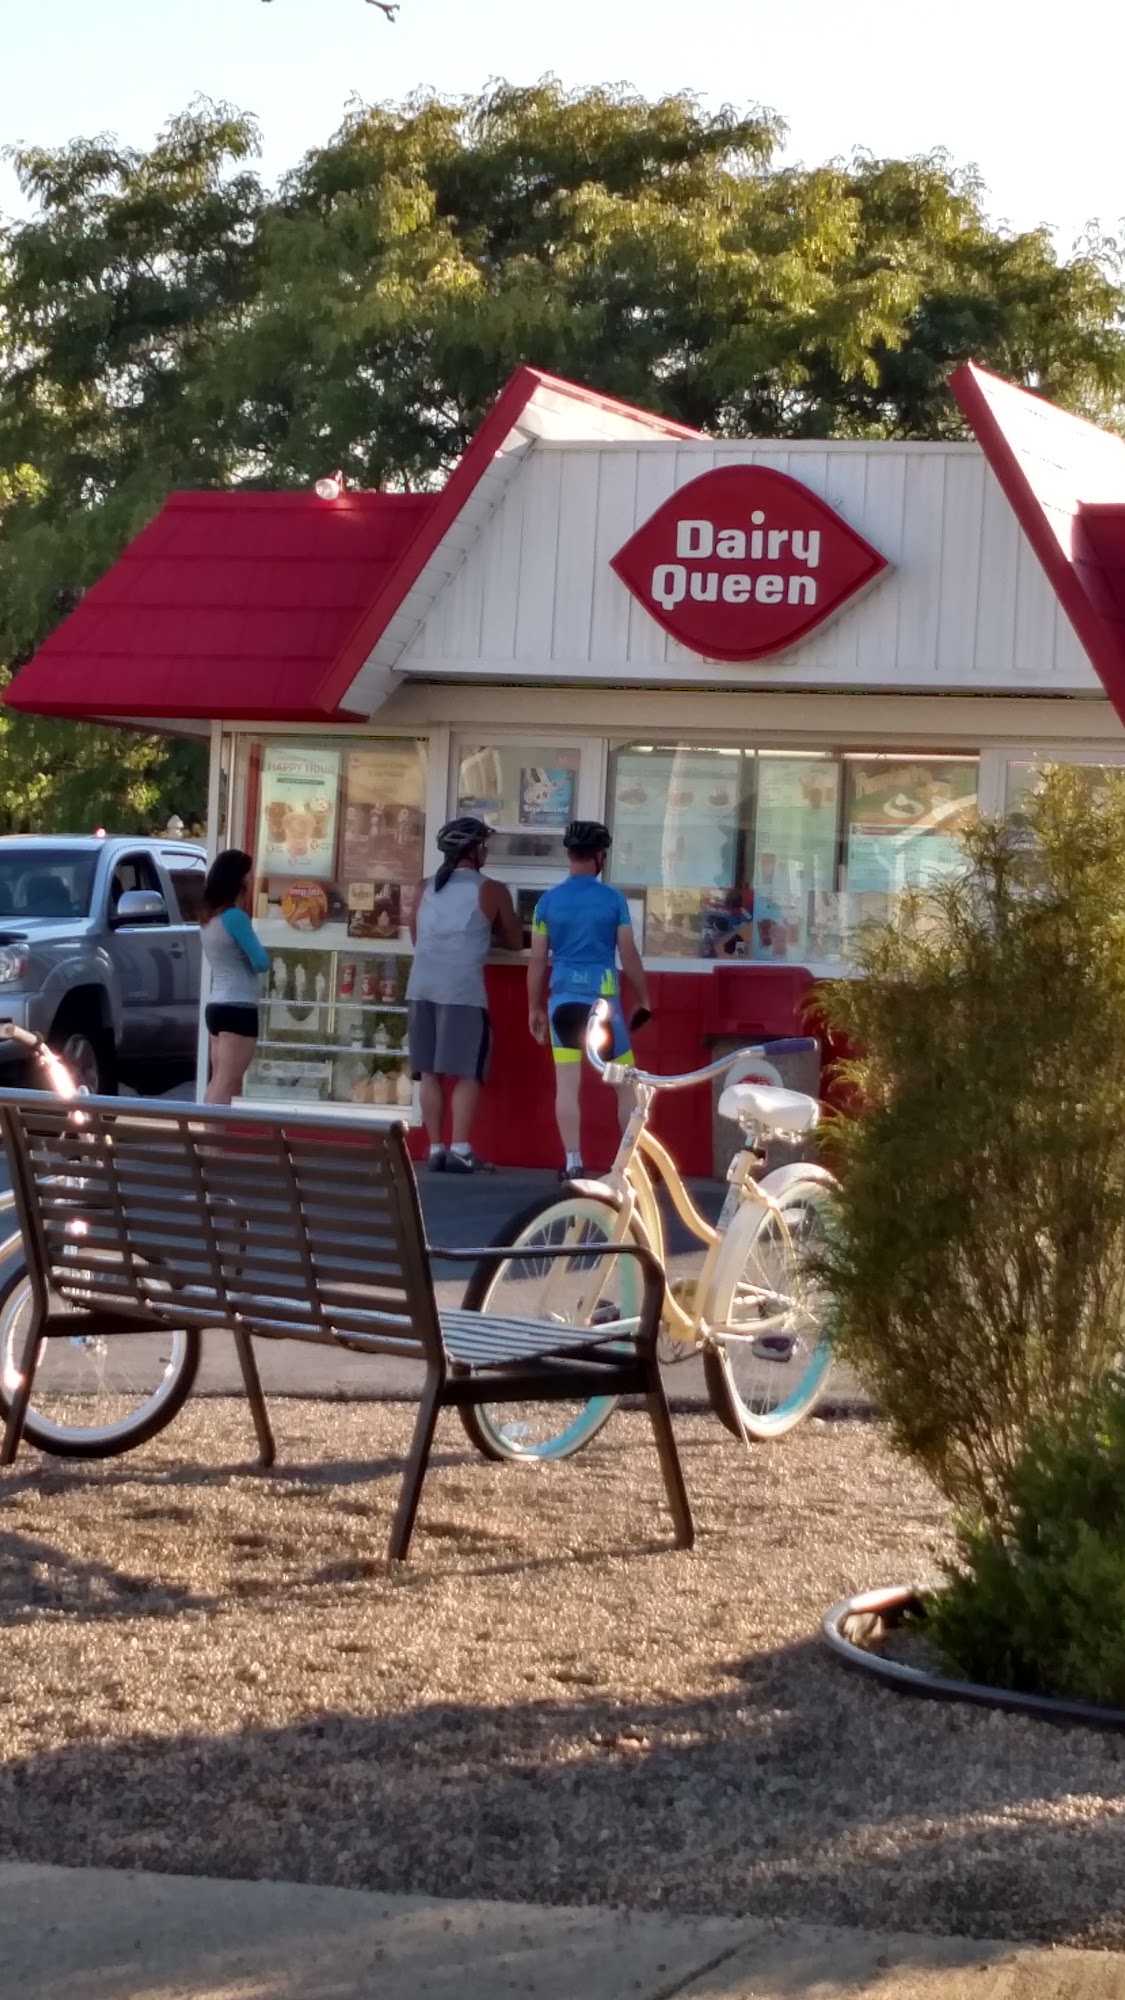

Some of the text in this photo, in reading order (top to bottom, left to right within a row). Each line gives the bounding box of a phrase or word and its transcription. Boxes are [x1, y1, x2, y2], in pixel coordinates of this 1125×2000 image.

[676, 510, 820, 567] Dairy
[651, 565, 816, 610] Queen
[268, 761, 336, 775] HAPPY HOUR
